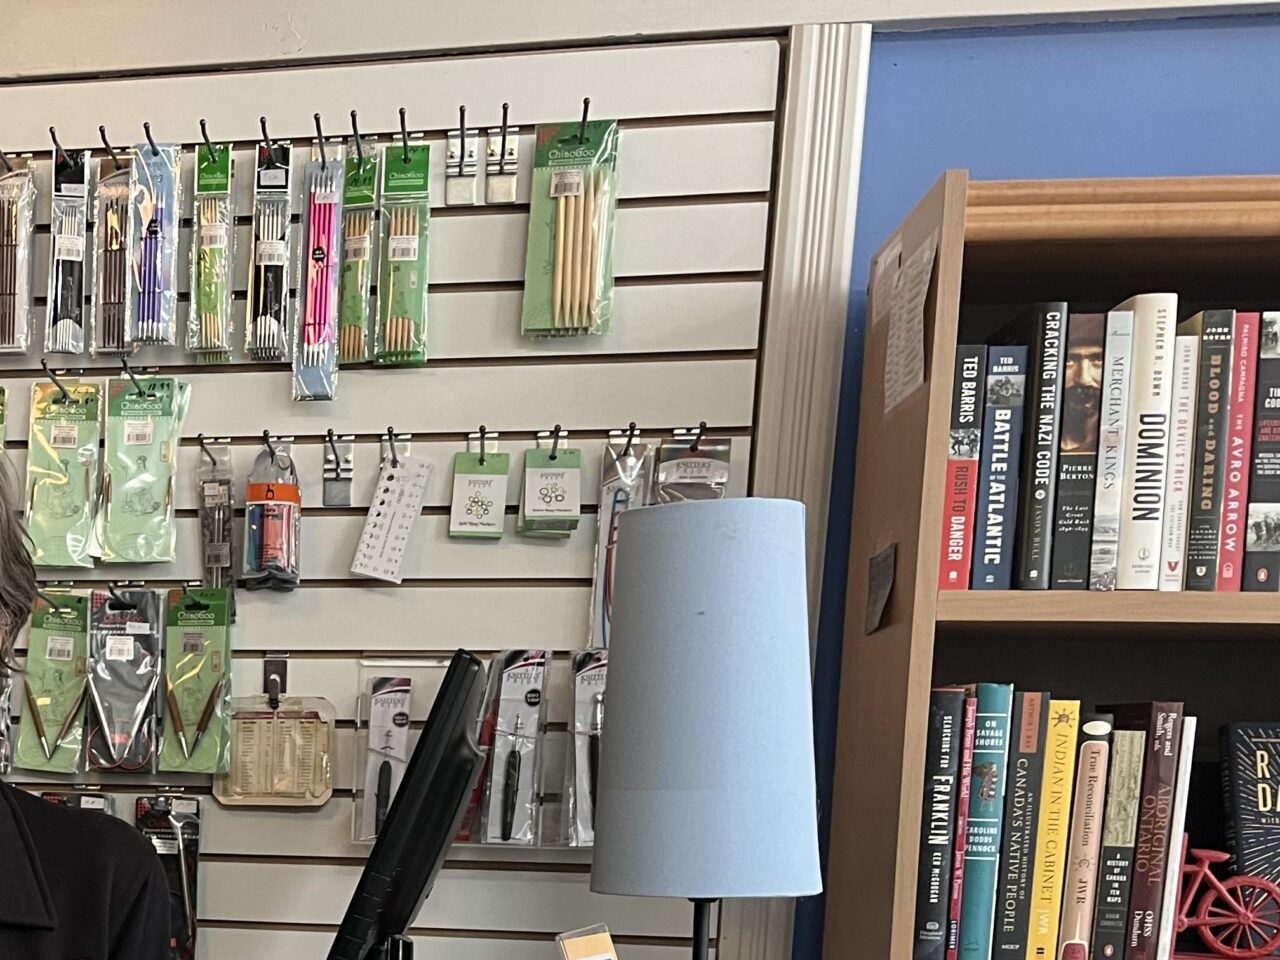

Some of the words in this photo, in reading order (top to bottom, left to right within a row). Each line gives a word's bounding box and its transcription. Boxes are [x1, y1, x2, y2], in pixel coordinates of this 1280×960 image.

[1041, 311, 1061, 379] CRACKING
[1155, 309, 1167, 350] STEPHEN
[1241, 324, 1249, 357] PALMIRO
[963, 356, 978, 378] TED
[992, 365, 1019, 373] BARRIS
[1000, 357, 1013, 365] TED
[1040, 384, 1054, 409] THE
[1107, 356, 1124, 436] MERCHANT
[1152, 370, 1163, 397] BOWN
[1208, 354, 1222, 414] BLOOD
[1238, 359, 1247, 403] CAMPAGNA
[959, 380, 977, 424] BARRIS
[1178, 397, 1189, 413] THE
[1036, 414, 1054, 445] NAZI
[1175, 419, 1188, 458] DEVIL'S
[1235, 414, 1244, 430] THE
[991, 409, 1012, 472] BATTLE
[1035, 451, 1051, 486] CODE
[1060, 472, 1094, 480] BERTON
[1062, 464, 1093, 472] PIERRE
[1103, 445, 1118, 490] KINGS
[1132, 413, 1167, 522] DOMINION
[1201, 439, 1217, 510] DARING
[1229, 436, 1244, 482] AVRO
[954, 466, 969, 496] RUSH
[1173, 464, 1185, 492] TRICK
[952, 498, 967, 513] TO
[984, 481, 1006, 565] ATLANTIC
[1224, 488, 1239, 551] ARROW
[948, 515, 966, 562] DANGER
[941, 715, 952, 752] SEARCHING
[986, 720, 996, 728] ON
[975, 738, 1003, 746] SHORES
[1052, 733, 1068, 785] INDIAN
[1164, 742, 1173, 756] and
[940, 755, 949, 768] FOR
[1088, 750, 1100, 774] True
[928, 775, 954, 845] FRANKLIN
[1012, 758, 1028, 827] CANADA'S
[1050, 789, 1063, 804] IN
[1021, 804, 1032, 853] ILLUSTRATED
[1047, 808, 1060, 836] THE
[1081, 776, 1098, 846] Reconciliation
[1137, 795, 1156, 872] ONTARIO
[1148, 782, 1171, 886] ABORIGINAL
[933, 852, 942, 866] KEN
[1007, 832, 1022, 880] NATIVE
[1040, 840, 1057, 900] CABINET
[929, 868, 941, 903] McGOOGAN
[1018, 889, 1026, 899] OF
[1076, 879, 1088, 904] JWR
[1003, 885, 1017, 932] PEOPLE
[1035, 908, 1049, 935] JWR
[949, 920, 957, 949] LORIMER
[1131, 910, 1144, 947] Dundurn
